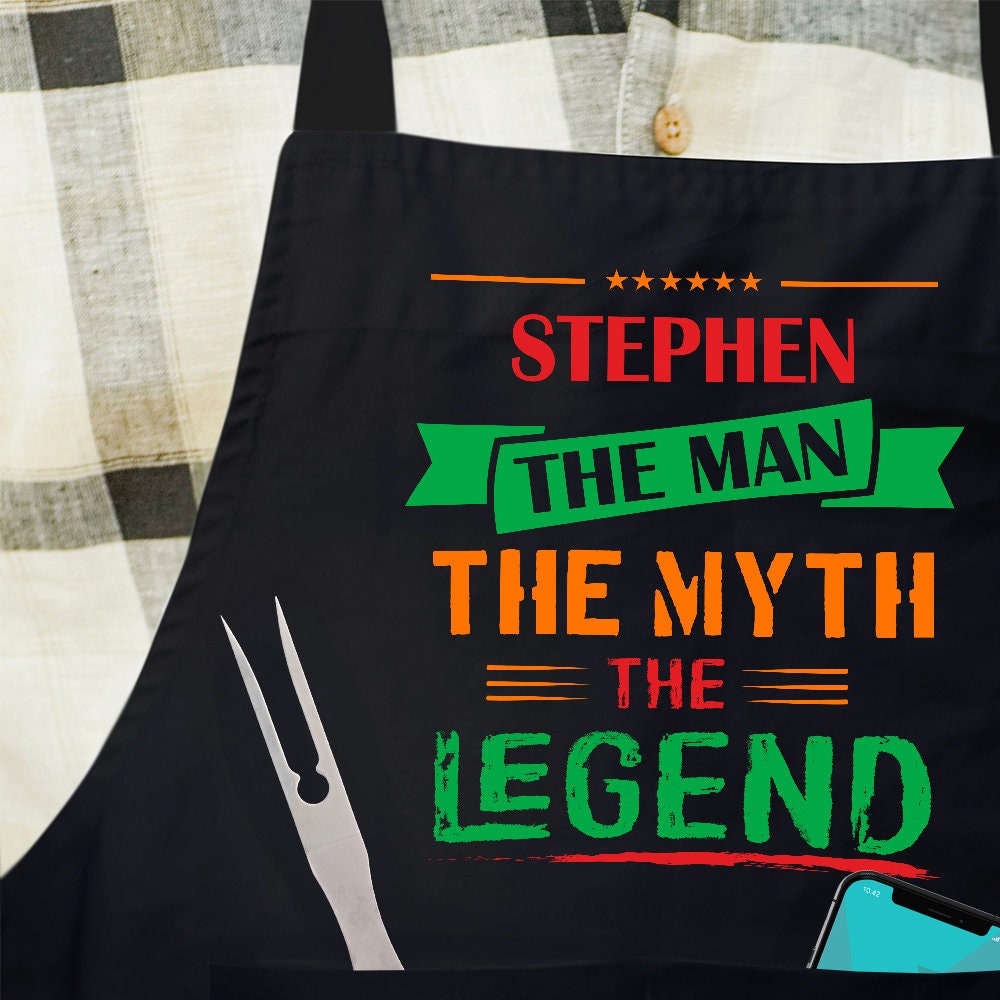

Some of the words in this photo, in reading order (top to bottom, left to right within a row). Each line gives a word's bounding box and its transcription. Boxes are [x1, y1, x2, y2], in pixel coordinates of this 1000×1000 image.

[512, 314, 854, 383] STEPHEN
[513, 441, 665, 513] THE
[688, 418, 848, 494] MAN
[433, 549, 621, 636] THE
[654, 550, 934, 638] MYTH
[607, 658, 725, 709] THE
[434, 730, 931, 855] LEGEND
